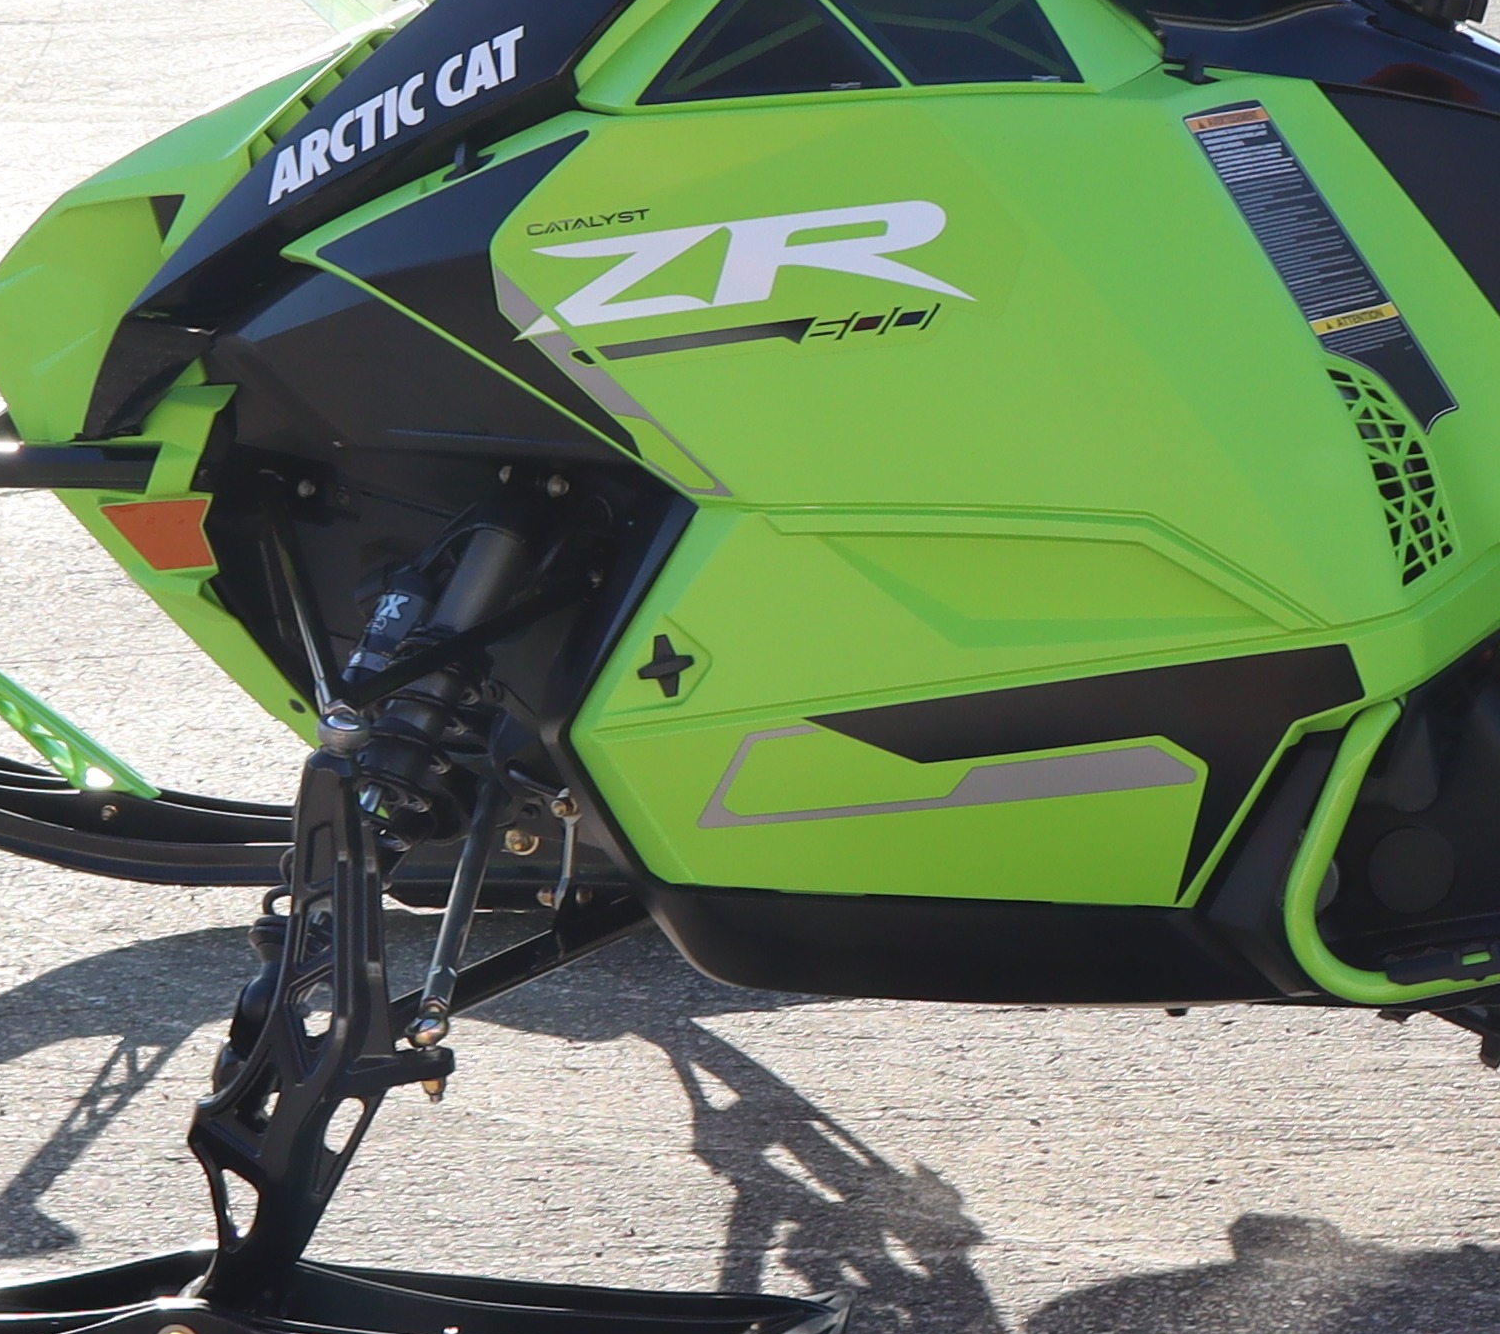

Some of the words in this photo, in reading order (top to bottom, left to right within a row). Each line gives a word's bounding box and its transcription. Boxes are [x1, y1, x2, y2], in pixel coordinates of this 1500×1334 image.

[268, 71, 426, 206] ARCTIC
[435, 24, 525, 108] CAT
[526, 208, 651, 237] CATALYST
[513, 199, 979, 342] ZR
[1337, 309, 1385, 327] ATTENTION
